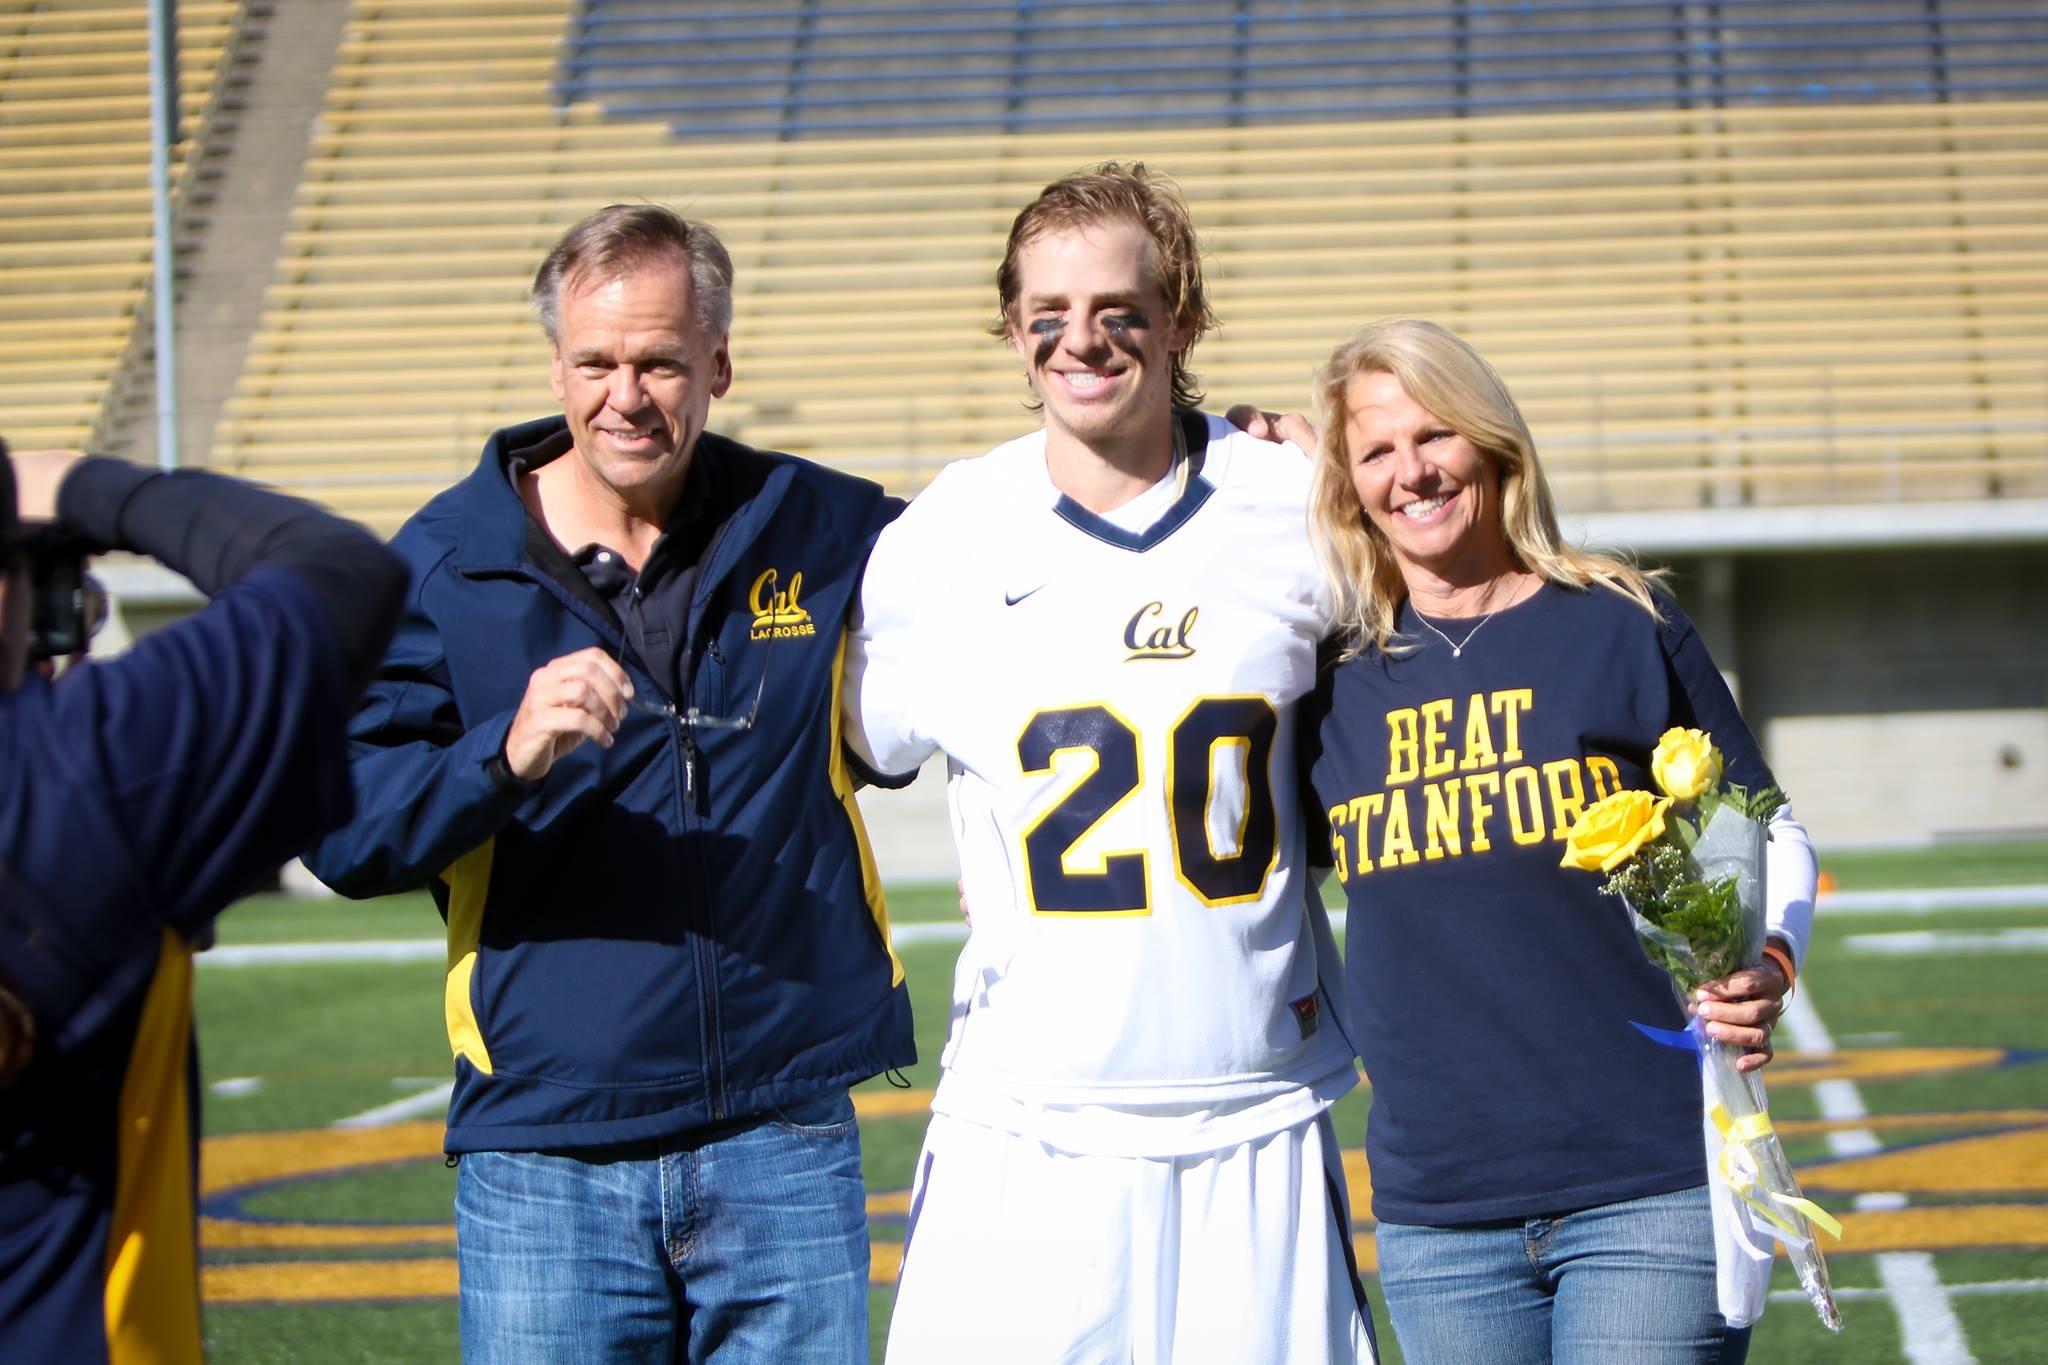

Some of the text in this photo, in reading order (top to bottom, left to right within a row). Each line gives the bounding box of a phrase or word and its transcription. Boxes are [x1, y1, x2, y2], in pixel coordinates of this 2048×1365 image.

[749, 568, 807, 628] Cal
[1122, 601, 1199, 663] Cal
[1385, 688, 1533, 785] BEAT
[1017, 692, 1279, 917] 20
